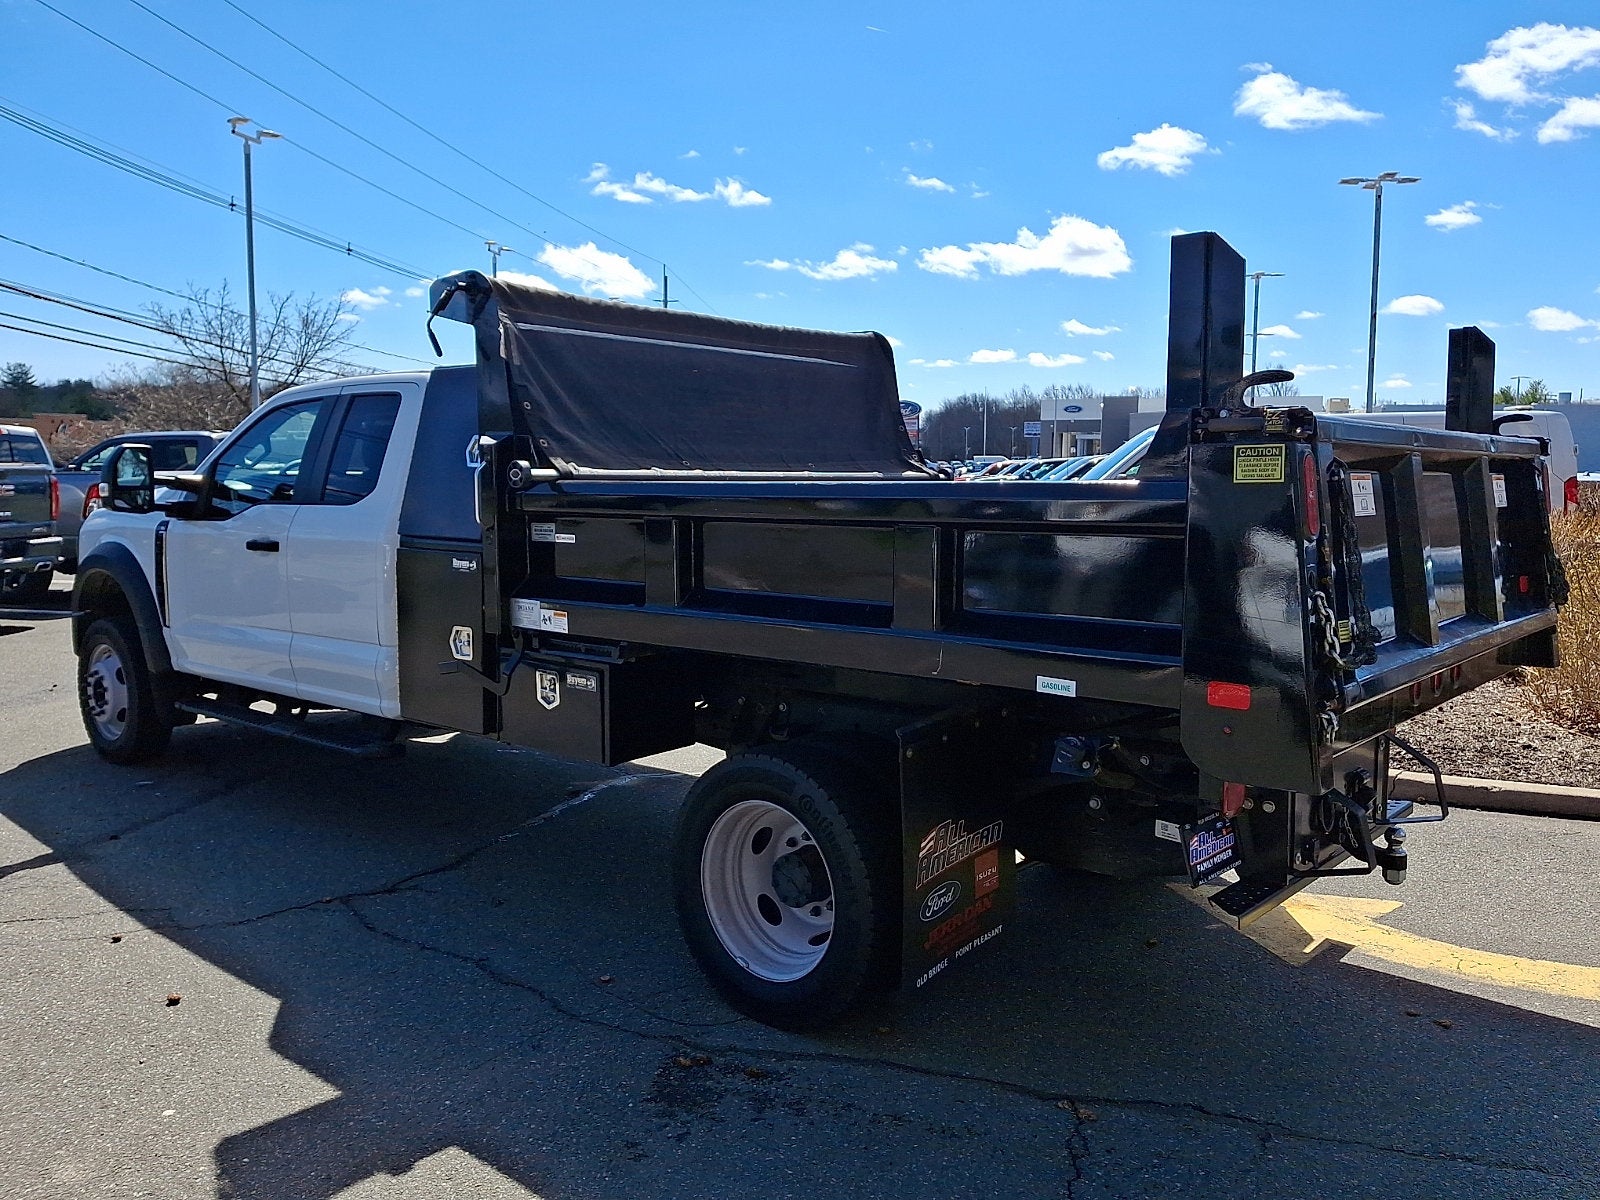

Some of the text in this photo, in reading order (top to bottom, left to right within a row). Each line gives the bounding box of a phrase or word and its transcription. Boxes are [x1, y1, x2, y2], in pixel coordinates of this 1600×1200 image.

[1239, 448, 1280, 456] CAUTION
[1041, 681, 1071, 692] GASOLINE
[934, 819, 967, 852] ALL
[1197, 831, 1216, 848] ALL
[916, 820, 1003, 890] AMERICAN
[1189, 833, 1235, 866] AMERICAN
[1196, 849, 1233, 873] FAMILY MEMBER
[976, 865, 997, 881] ISUZU
[925, 886, 955, 917] Ford
[916, 924, 1003, 988] OLD BRIDGE POINT PLEASANT
